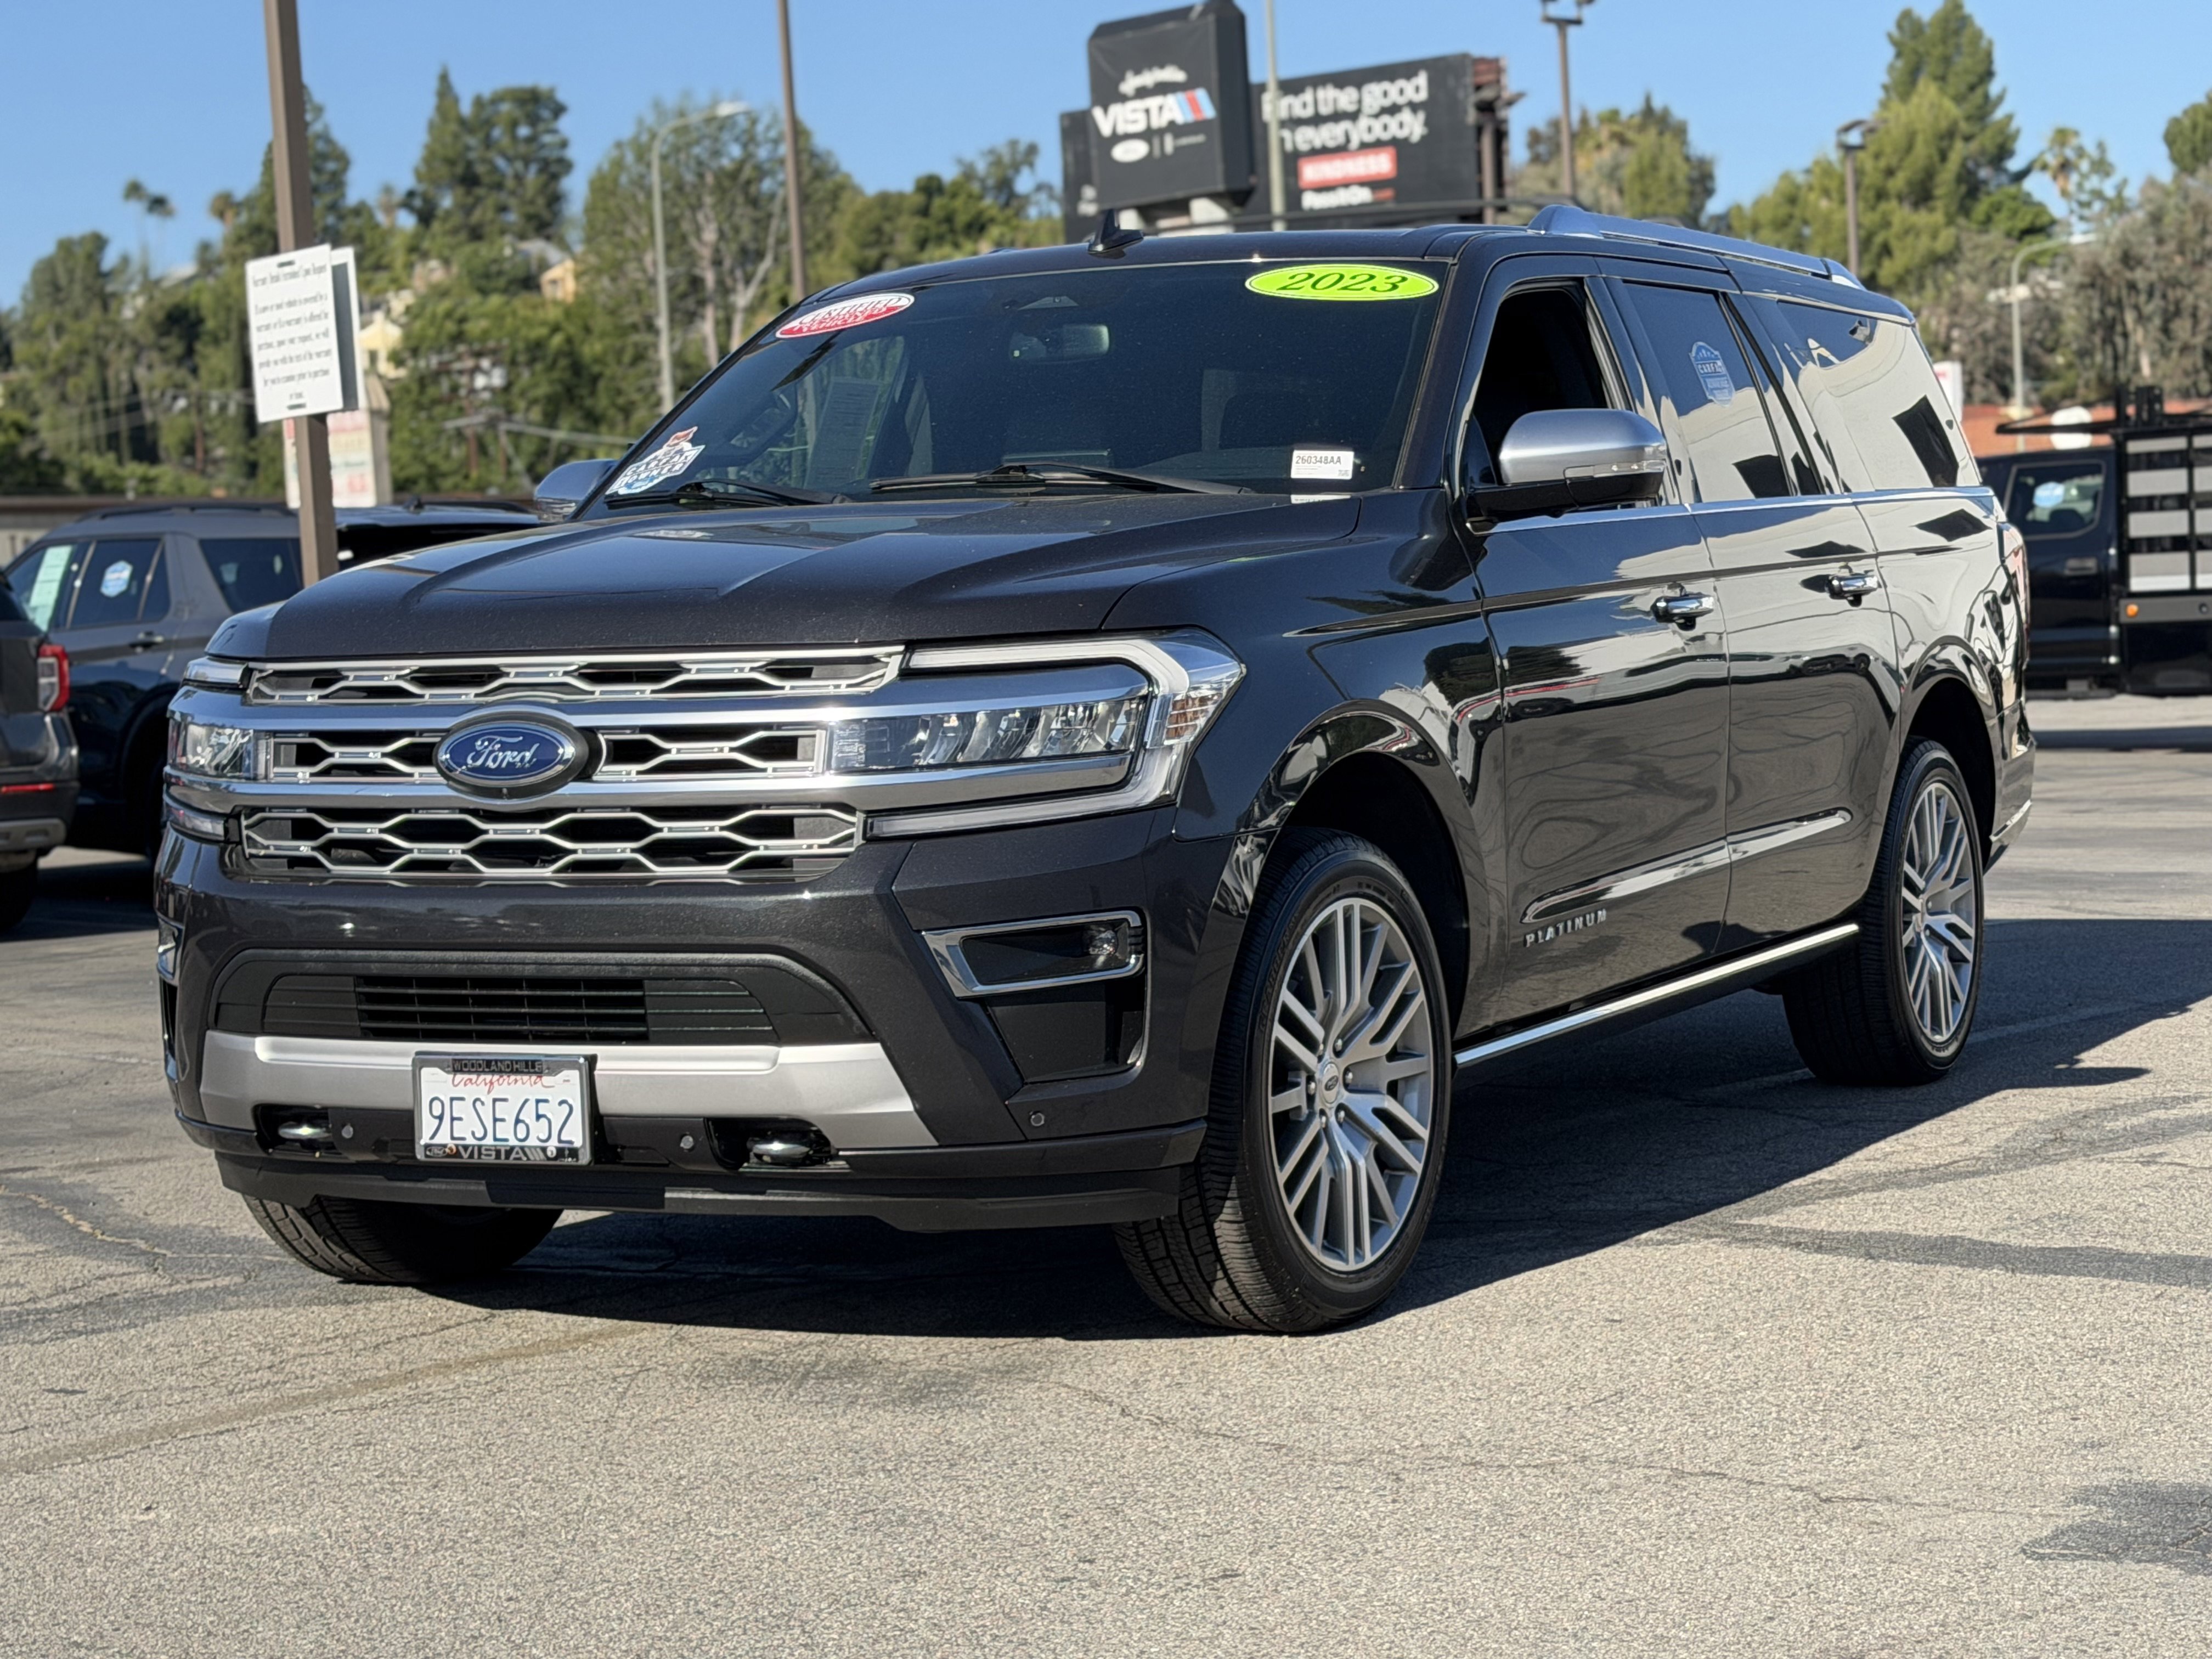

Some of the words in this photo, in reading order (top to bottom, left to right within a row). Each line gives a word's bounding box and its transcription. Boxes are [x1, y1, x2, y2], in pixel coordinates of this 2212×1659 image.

[1316, 83, 1359, 116] the
[1361, 69, 1429, 116] good
[1092, 94, 1185, 138] VISTA
[1276, 272, 1408, 292] 2023
[626, 449, 698, 476] CARFAX
[628, 463, 684, 483] OWNER
[1295, 455, 1342, 465] 260348AA
[467, 735, 540, 769] Ford
[1525, 908, 1607, 948] PLATINUM
[453, 1060, 511, 1071] WOODLAND
[514, 1061, 543, 1073] HILLS
[428, 1096, 575, 1145] 9ESE652
[459, 1146, 527, 1160] VISTA
